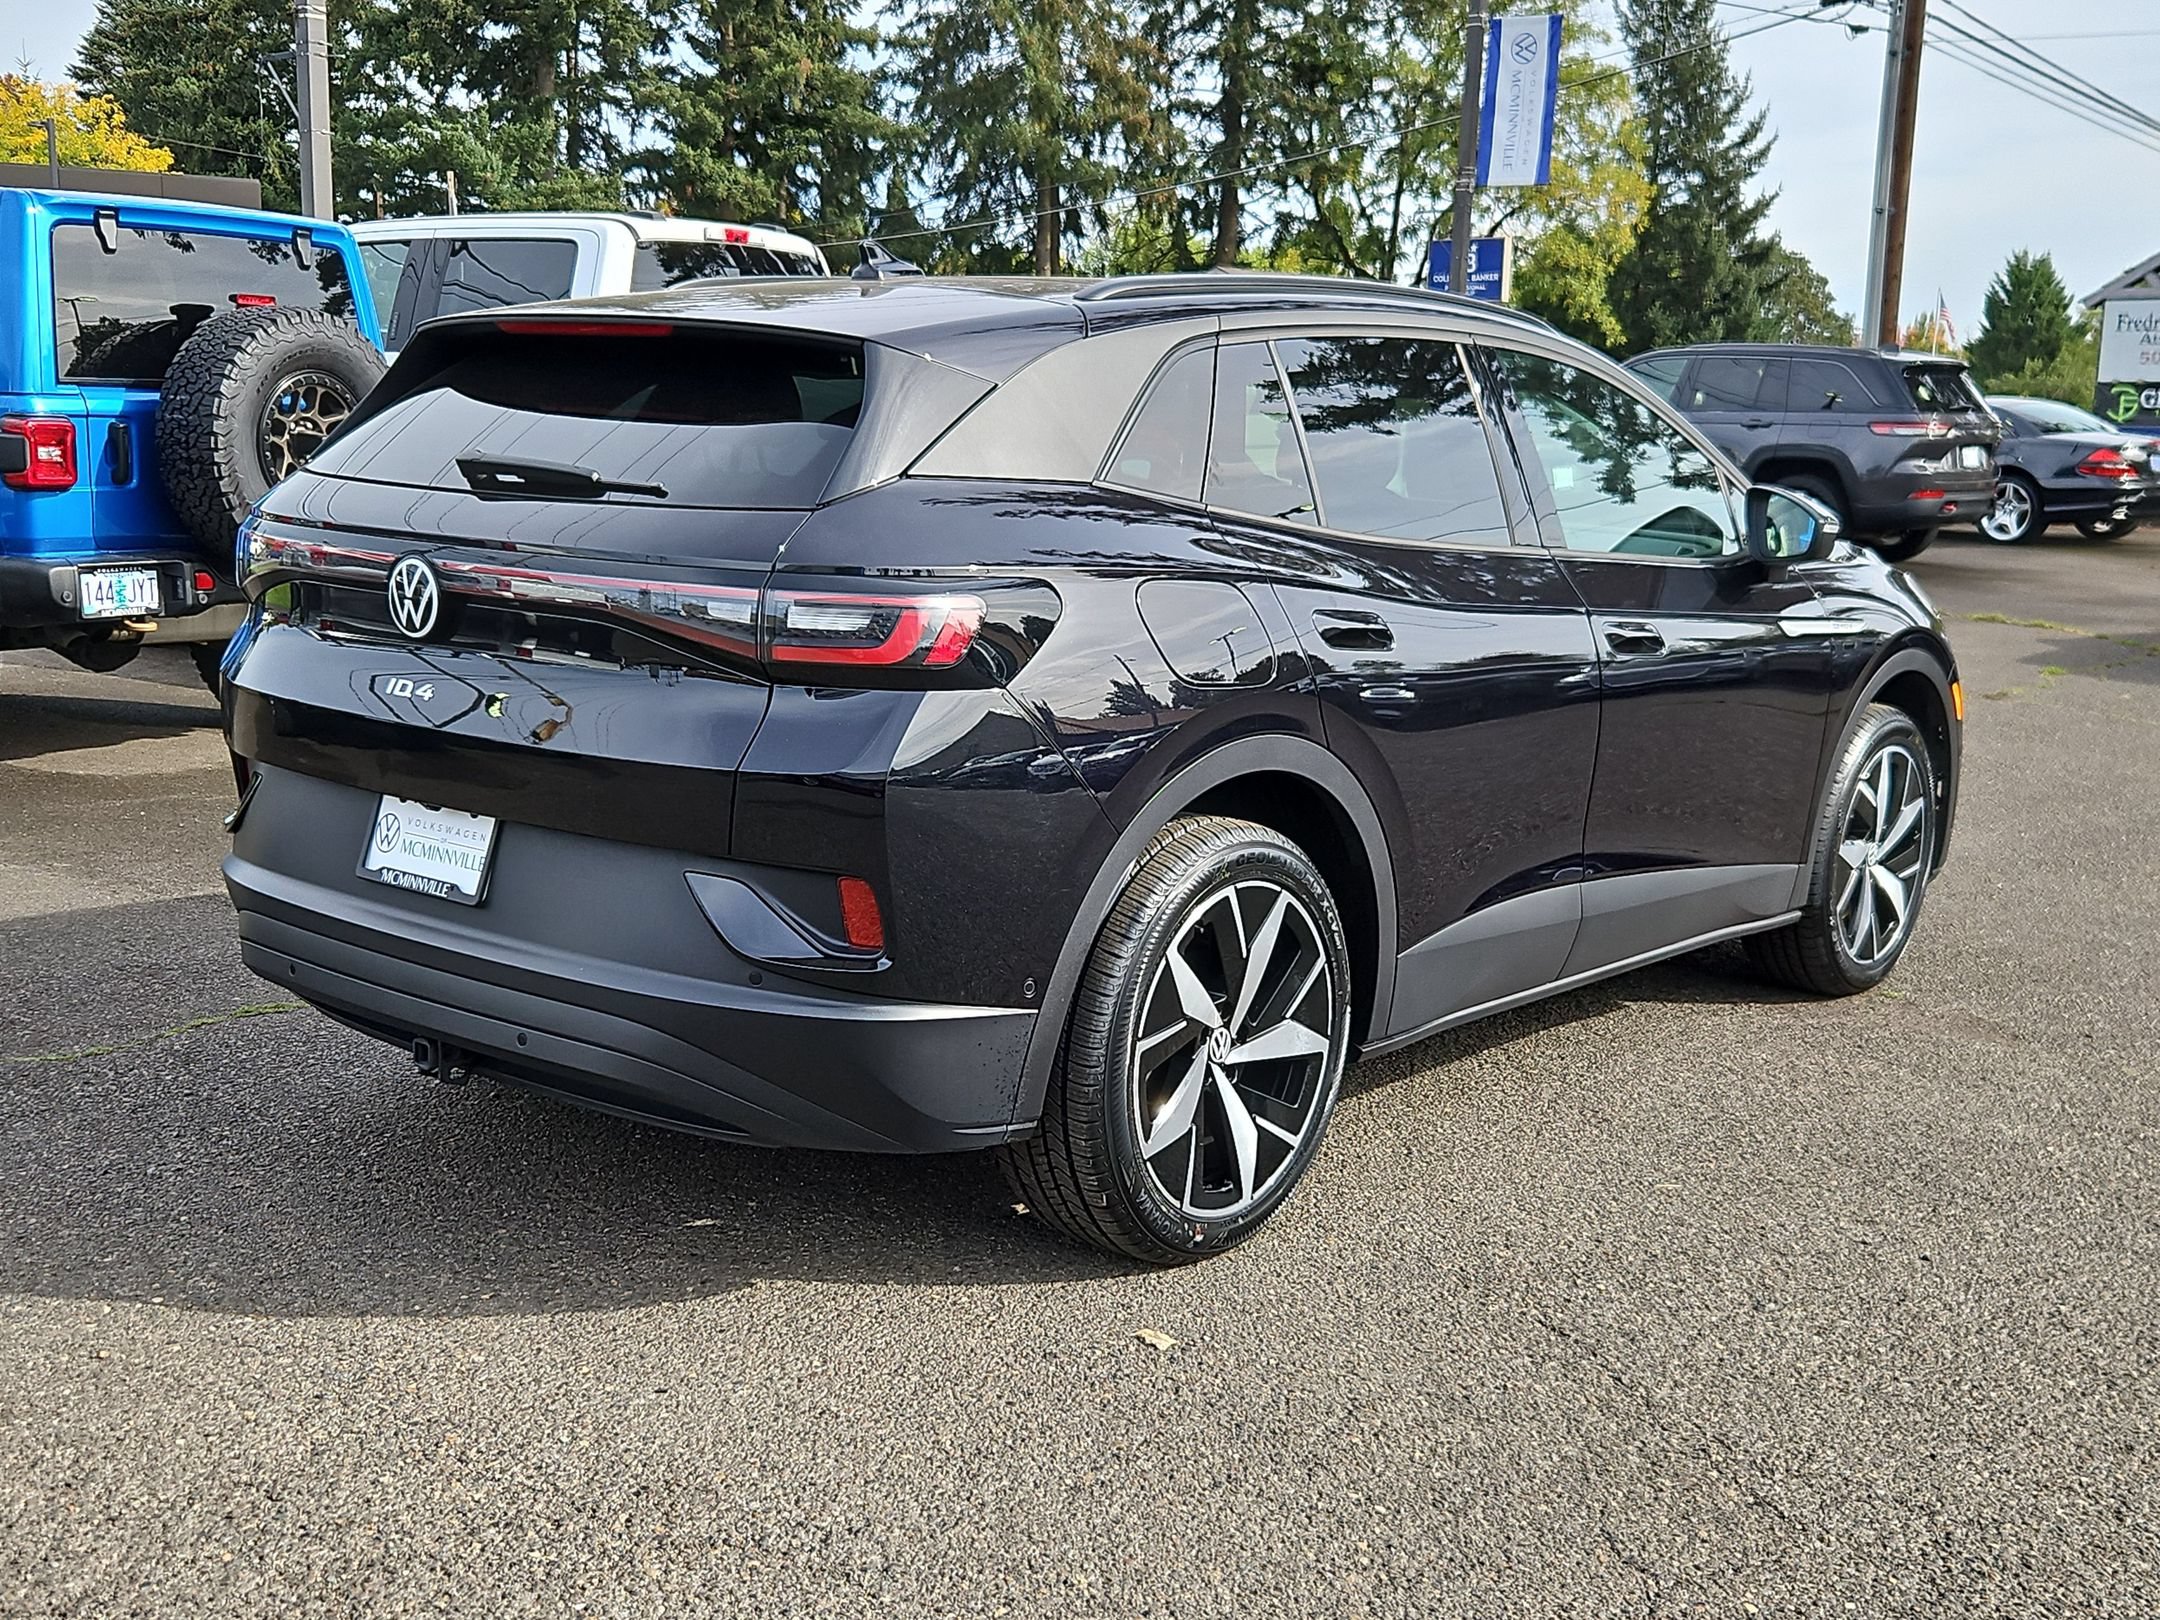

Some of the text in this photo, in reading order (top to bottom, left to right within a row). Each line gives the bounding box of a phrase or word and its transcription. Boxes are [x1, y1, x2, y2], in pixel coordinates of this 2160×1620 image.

[1503, 70, 1522, 171] MCMINNVILLE
[85, 577, 157, 606] 144 JYT
[407, 816, 487, 842] VOLKSWAGEN
[400, 838, 486, 873] MCMINNVILLE
[380, 868, 451, 898] MCMINNVILLE
